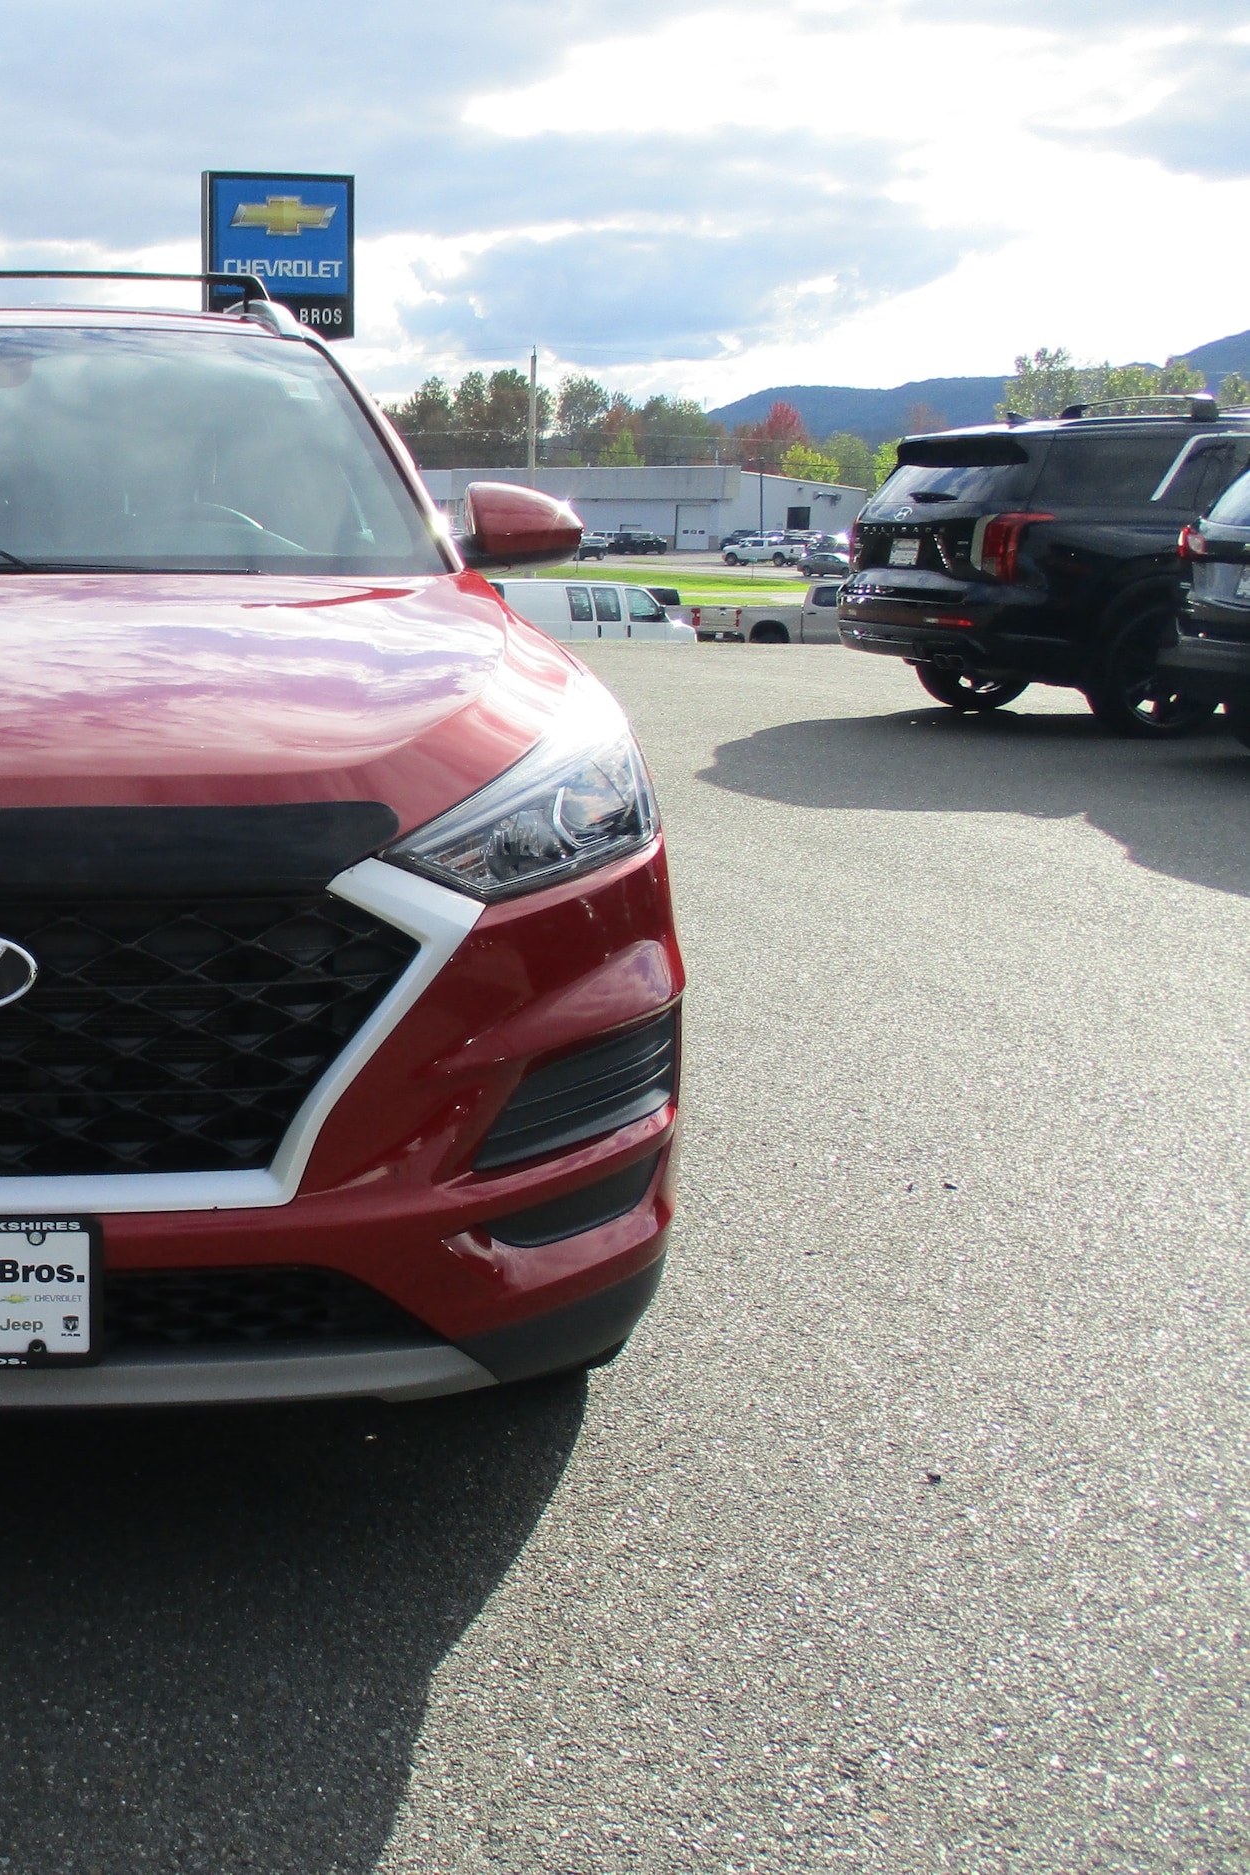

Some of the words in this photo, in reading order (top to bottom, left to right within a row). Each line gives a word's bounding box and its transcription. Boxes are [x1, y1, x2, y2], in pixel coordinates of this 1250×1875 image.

[223, 259, 343, 278] CHEVROLET
[299, 308, 343, 325] BROS
[34, 1294, 83, 1303] CHEVROLET
